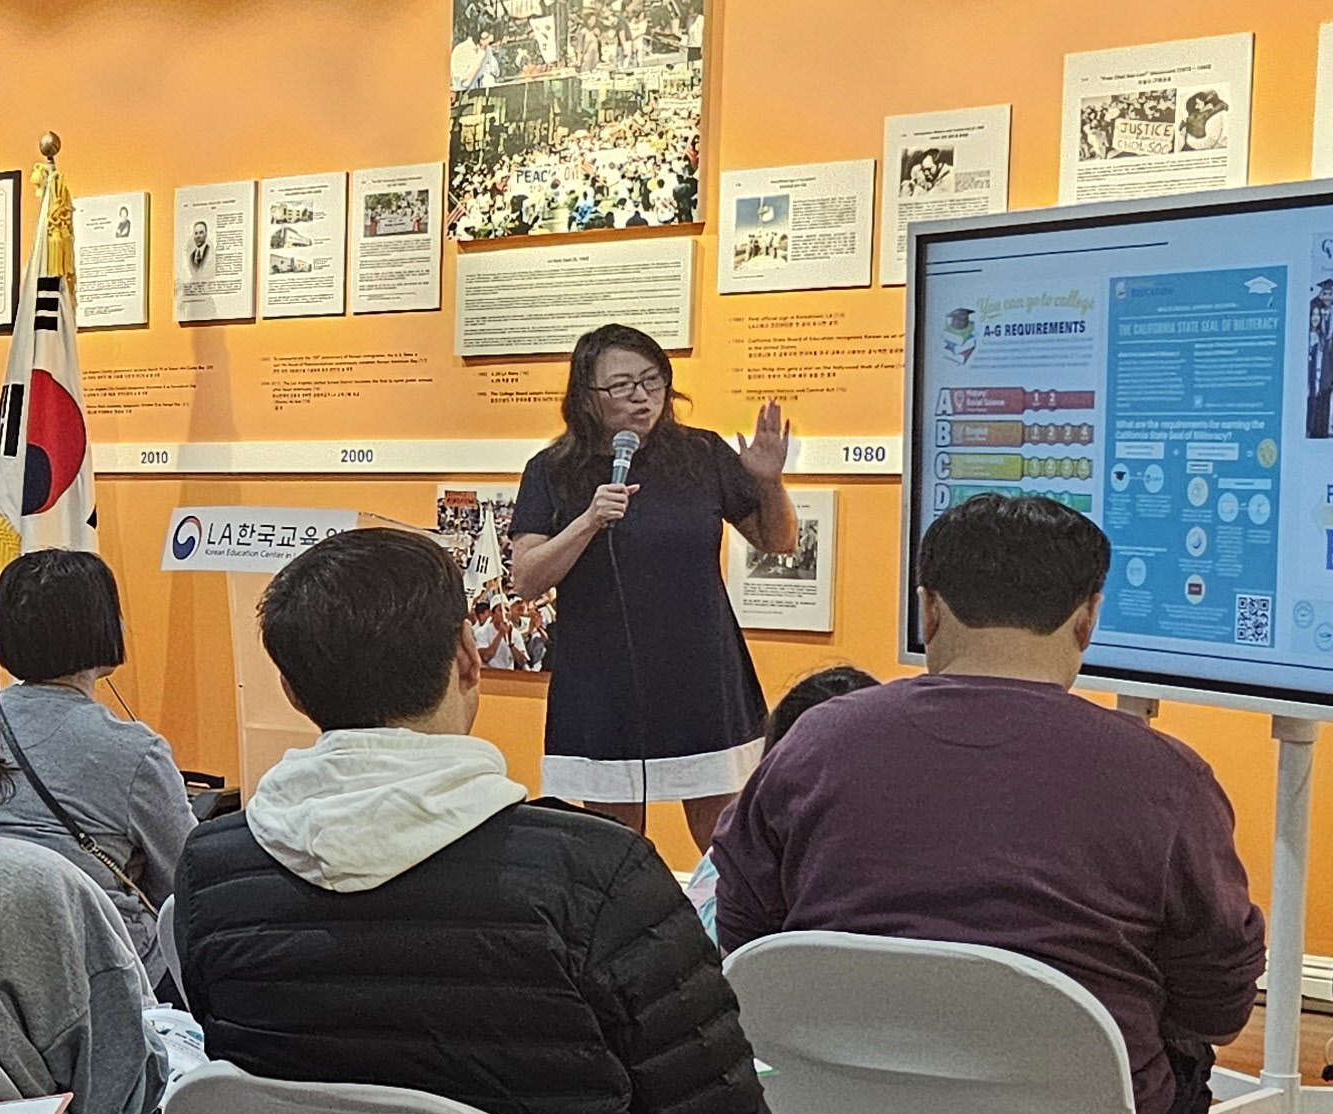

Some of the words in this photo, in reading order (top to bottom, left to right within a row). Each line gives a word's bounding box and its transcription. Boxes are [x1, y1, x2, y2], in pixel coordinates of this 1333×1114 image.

[1119, 122, 1174, 137] JUSTICE
[515, 169, 551, 184] PEAC
[1003, 299, 1024, 311] can
[983, 324, 1002, 337] A-G
[1004, 320, 1087, 337] REQUIREMENTS
[1177, 320, 1199, 334] STATE
[1201, 319, 1220, 333] SEAL
[1221, 319, 1232, 332] OF
[935, 387, 953, 415] A
[935, 419, 952, 447] B
[140, 451, 169, 465] 2010
[340, 448, 374, 463] 2000
[842, 446, 886, 462] 1980
[206, 523, 344, 548] LA한국교육
[226, 549, 259, 558] Education
[260, 550, 284, 559] Center
